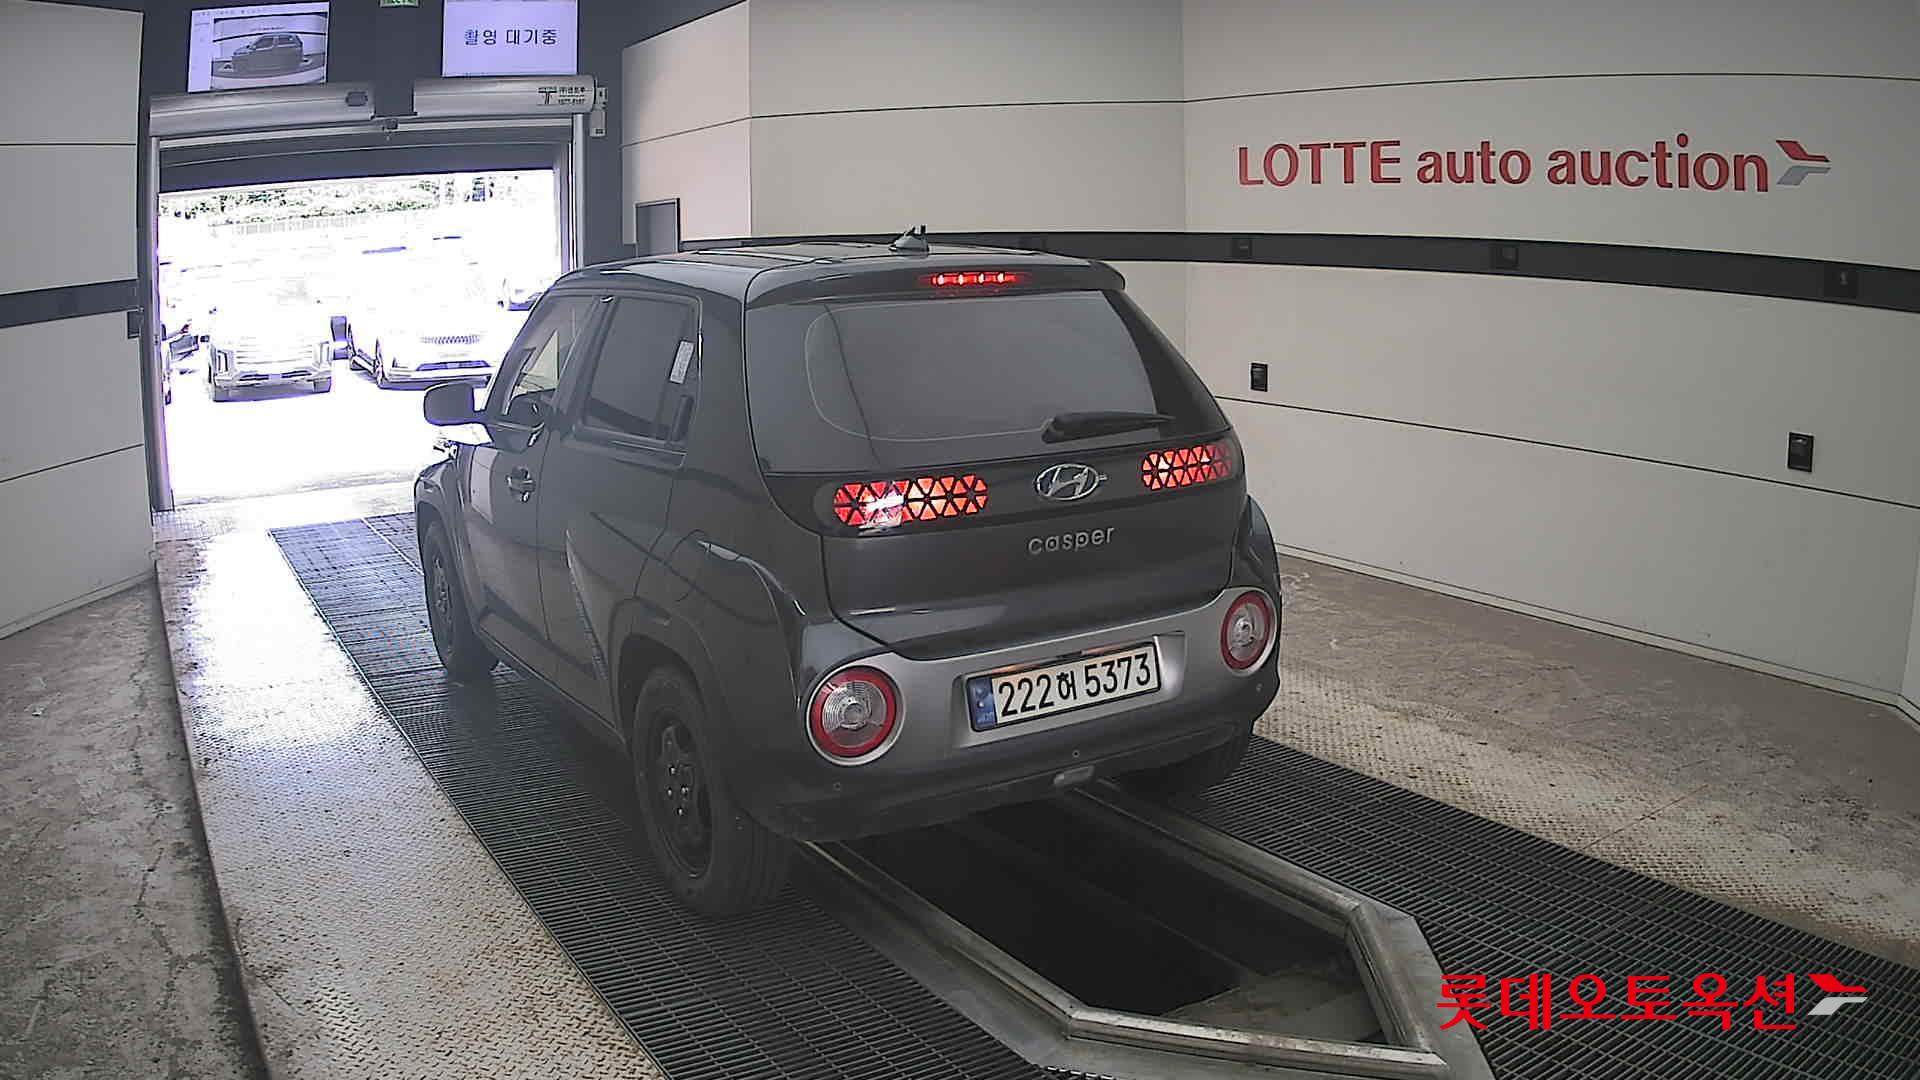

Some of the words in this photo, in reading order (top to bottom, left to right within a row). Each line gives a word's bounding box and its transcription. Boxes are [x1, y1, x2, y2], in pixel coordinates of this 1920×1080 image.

[464, 28, 498, 46] 촬영
[505, 28, 558, 46] 대기중
[1239, 140, 1401, 188] LOTTE
[1416, 140, 1533, 185] auto
[1547, 133, 1769, 192] auction
[1028, 527, 1115, 555] casper
[998, 670, 1078, 718] 222허
[1083, 652, 1152, 698] 5373
